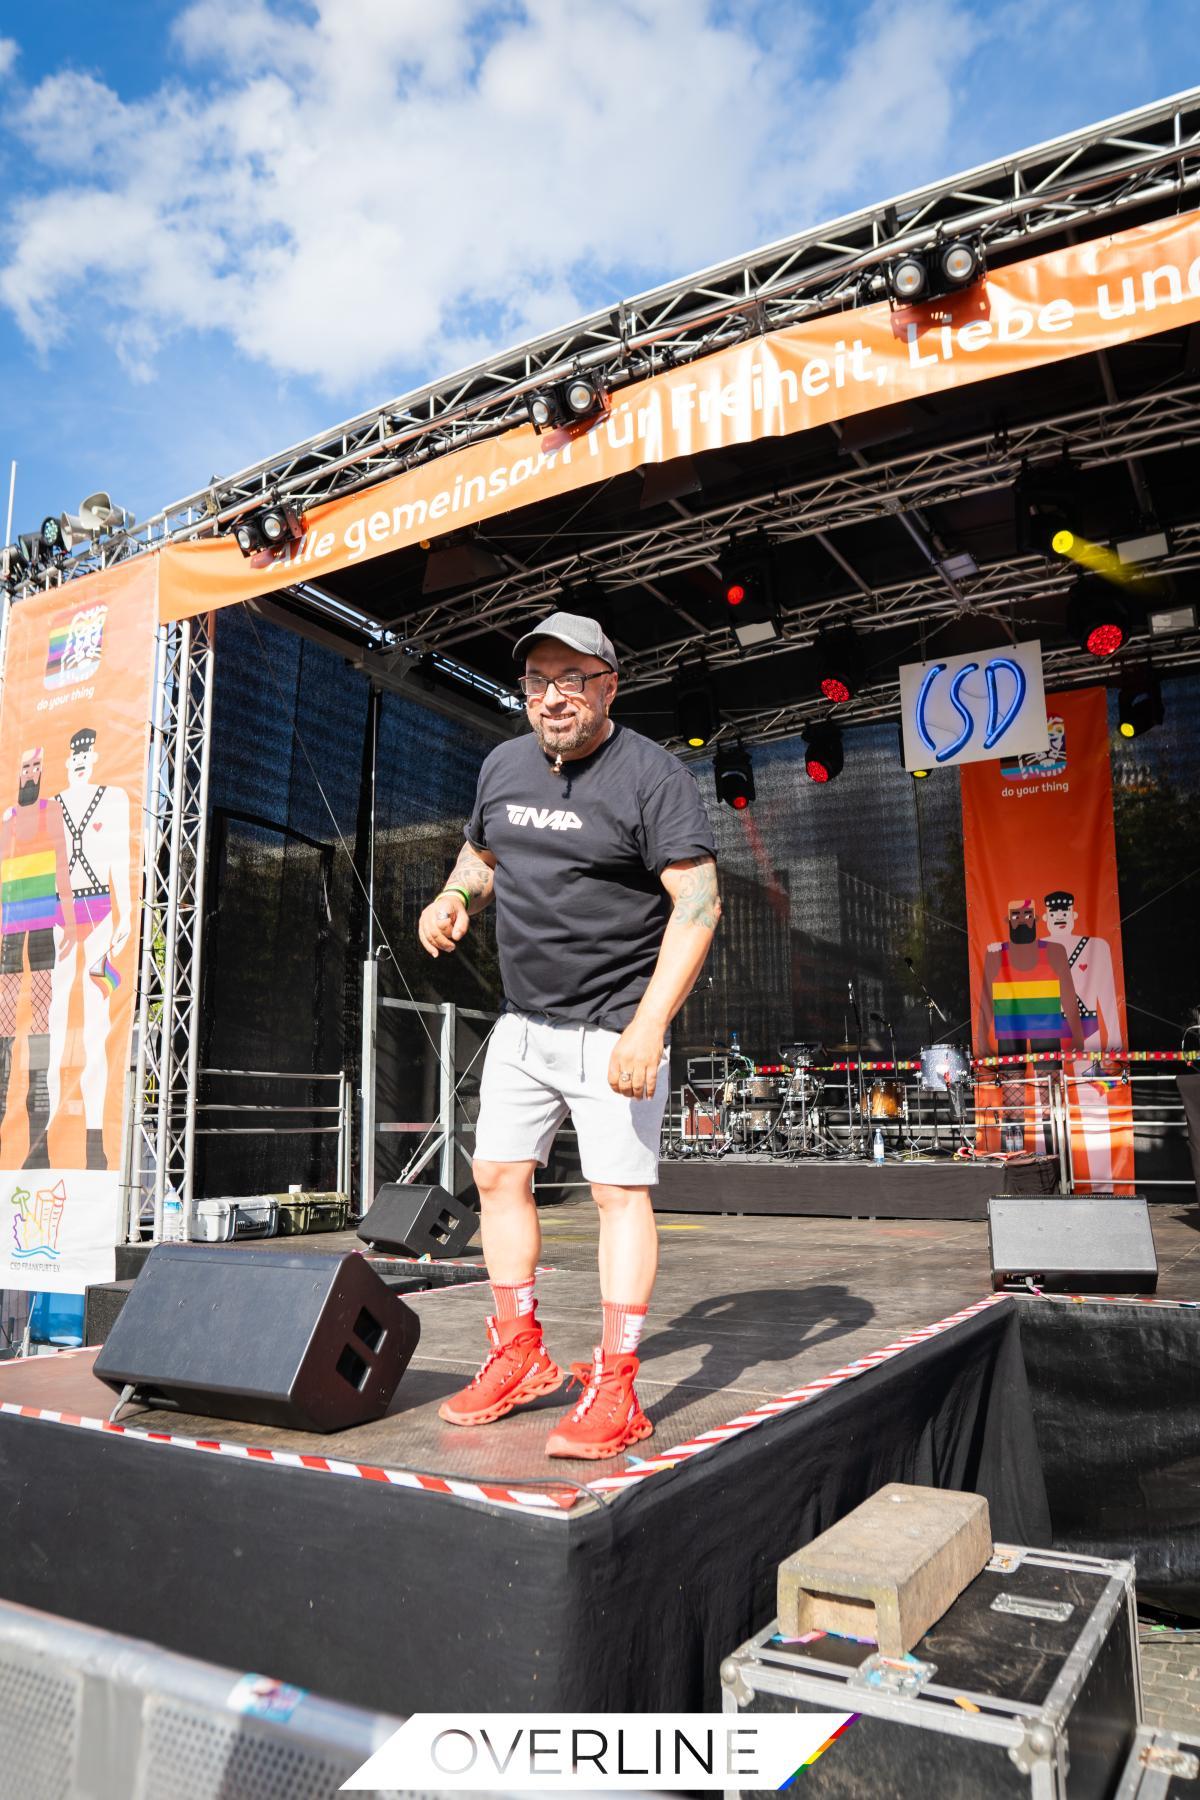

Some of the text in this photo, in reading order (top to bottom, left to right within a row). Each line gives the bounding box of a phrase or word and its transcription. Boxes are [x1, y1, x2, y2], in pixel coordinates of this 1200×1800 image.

[343, 442, 572, 560] gemeinsam
[671, 339, 888, 430] Freiheit,
[906, 290, 1075, 369] Liebe
[36, 685, 95, 712] do your thing
[916, 657, 1026, 763] CSD
[1001, 781, 1069, 798] do your thing
